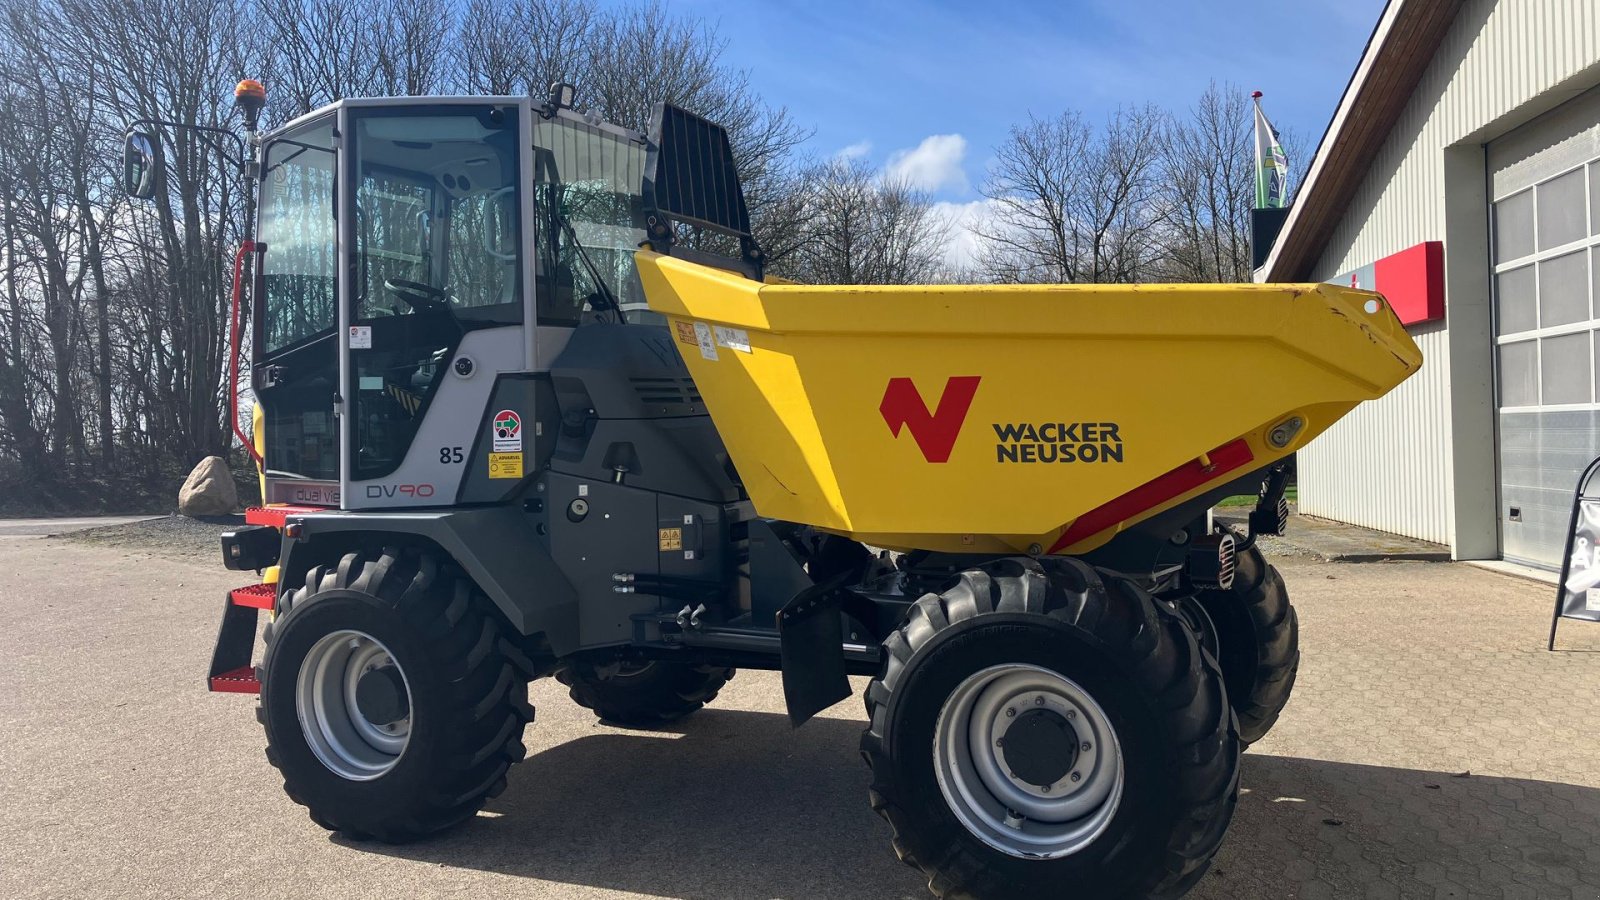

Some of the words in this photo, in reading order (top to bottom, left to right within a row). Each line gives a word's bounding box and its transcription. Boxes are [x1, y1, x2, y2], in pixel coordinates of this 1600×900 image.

[992, 422, 1123, 443] WACKER
[439, 447, 464, 464] 85
[996, 443, 1124, 463] NEUSON
[296, 488, 322, 501] dual
[324, 490, 340, 503] vie
[366, 484, 434, 498] DV90
